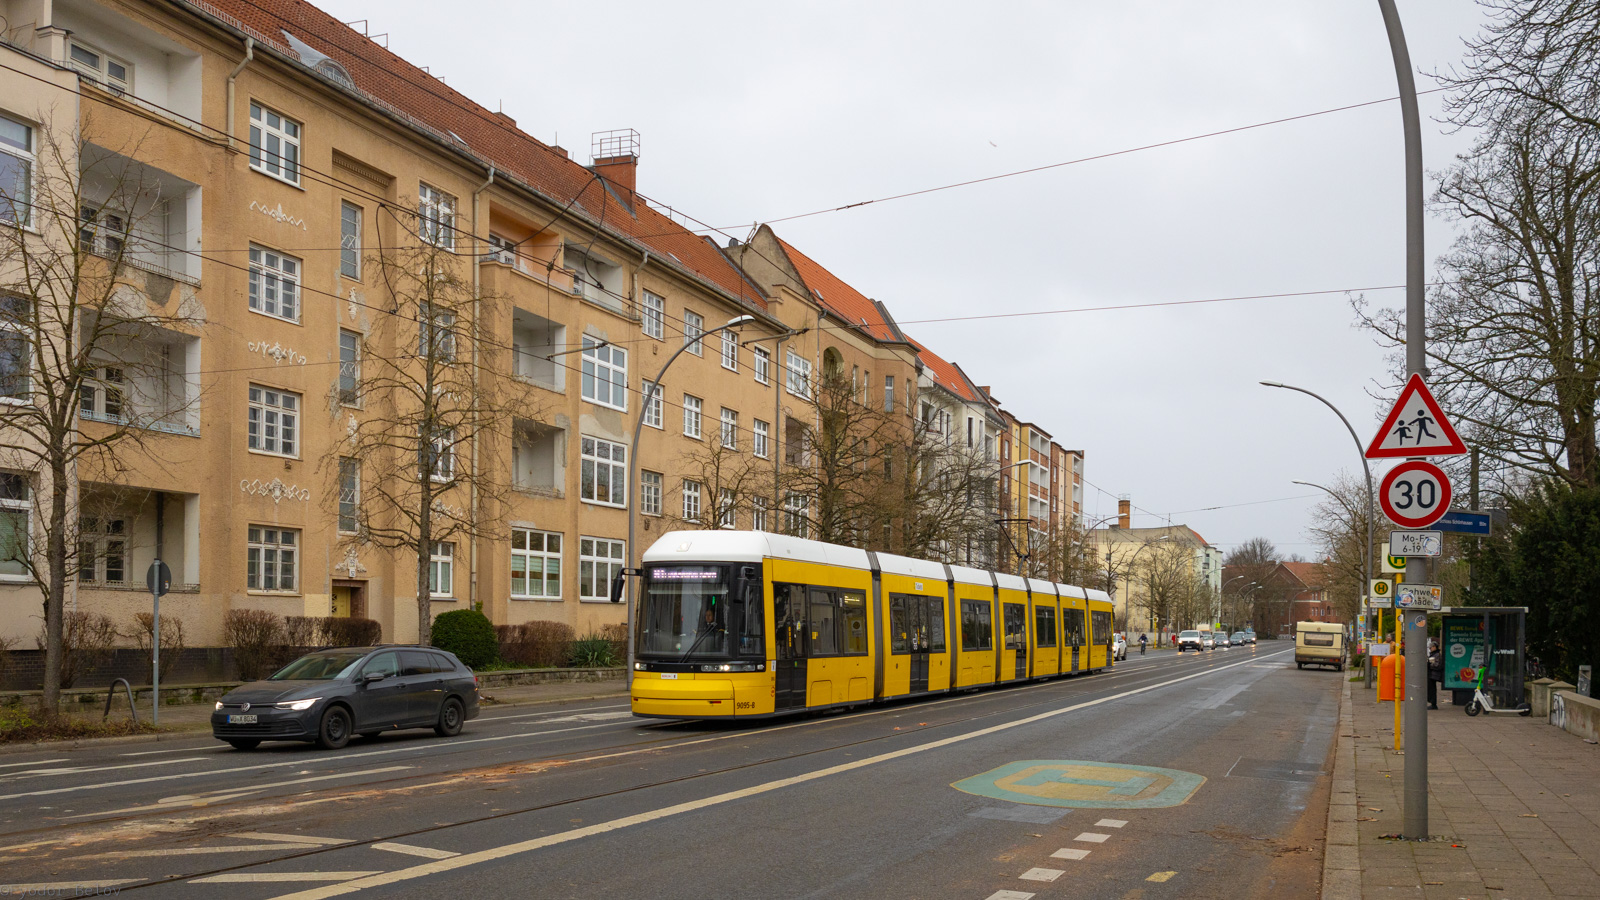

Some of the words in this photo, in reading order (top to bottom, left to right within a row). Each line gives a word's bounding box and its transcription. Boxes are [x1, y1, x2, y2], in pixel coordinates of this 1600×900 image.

[1394, 479, 1435, 509] 30
[1402, 545, 1421, 553] 6-19
[1377, 584, 1385, 592] H
